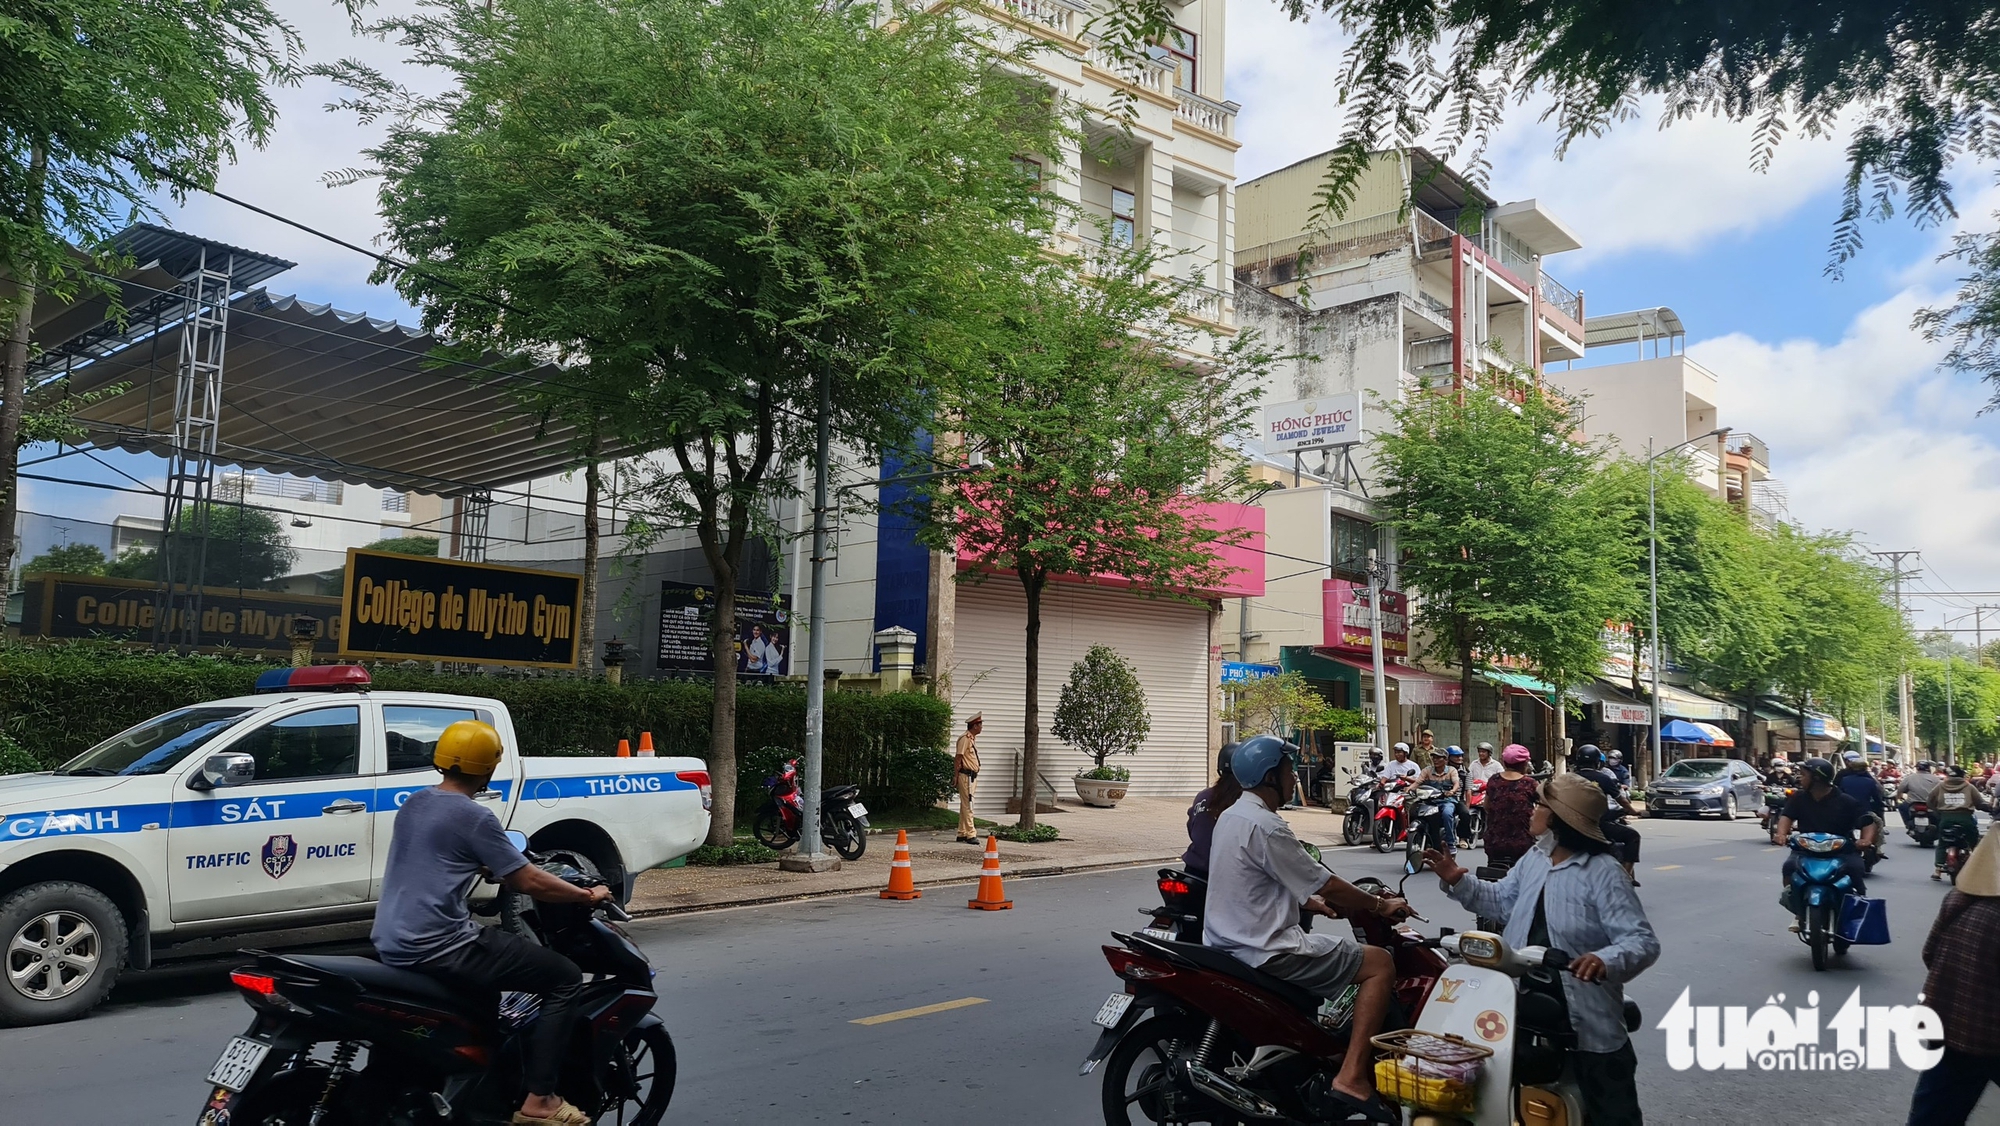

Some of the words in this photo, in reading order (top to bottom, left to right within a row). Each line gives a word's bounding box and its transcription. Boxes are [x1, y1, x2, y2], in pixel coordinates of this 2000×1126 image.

[1314, 410, 1352, 426] PHÚC
[1276, 430, 1308, 441] DIAMOND
[1312, 424, 1346, 436] JEWELRY
[1312, 437, 1324, 445] 1996
[357, 576, 436, 634] Collège
[438, 586, 464, 630] de
[466, 588, 528, 640] Mytho
[532, 594, 571, 644] Gym
[202, 606, 236, 634] de
[585, 775, 661, 794] THÔNG
[220, 798, 286, 822] SÁT
[9, 810, 120, 836] CẢNH
[186, 851, 250, 870] TRAFFIC
[306, 843, 356, 860] POLICE
[228, 1040, 262, 1066] 63-C1
